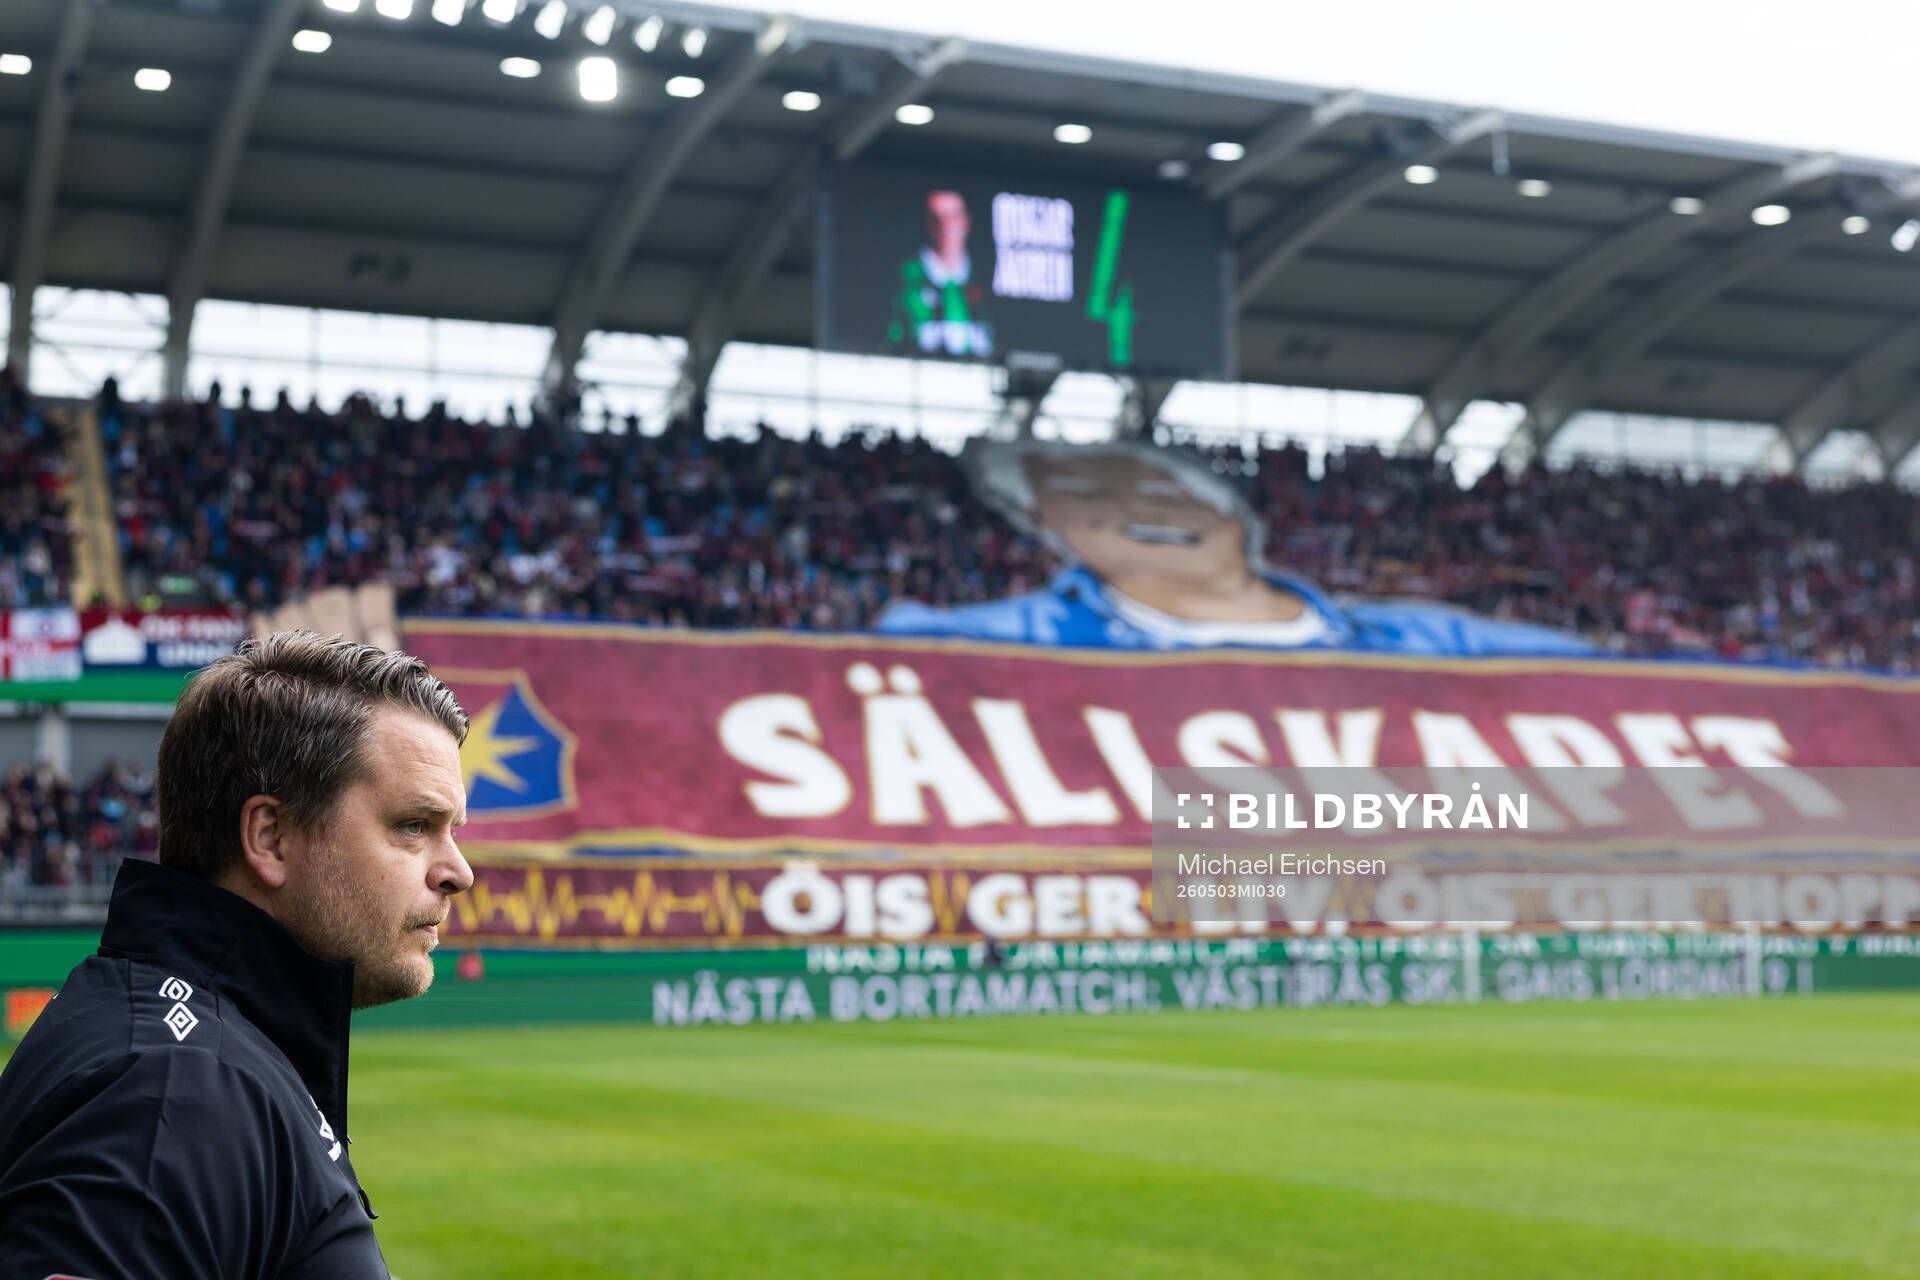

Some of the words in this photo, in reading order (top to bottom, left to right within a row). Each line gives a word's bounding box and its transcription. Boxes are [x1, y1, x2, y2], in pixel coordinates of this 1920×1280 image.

[1088, 190, 1136, 366] 4
[717, 662, 1846, 836] SÄLLSKAPET
[761, 860, 935, 937] ÖIS
[966, 872, 1152, 937] GER
[652, 969, 816, 1026] NÄSTA
[829, 969, 1162, 1021] BORTAMATCH:
